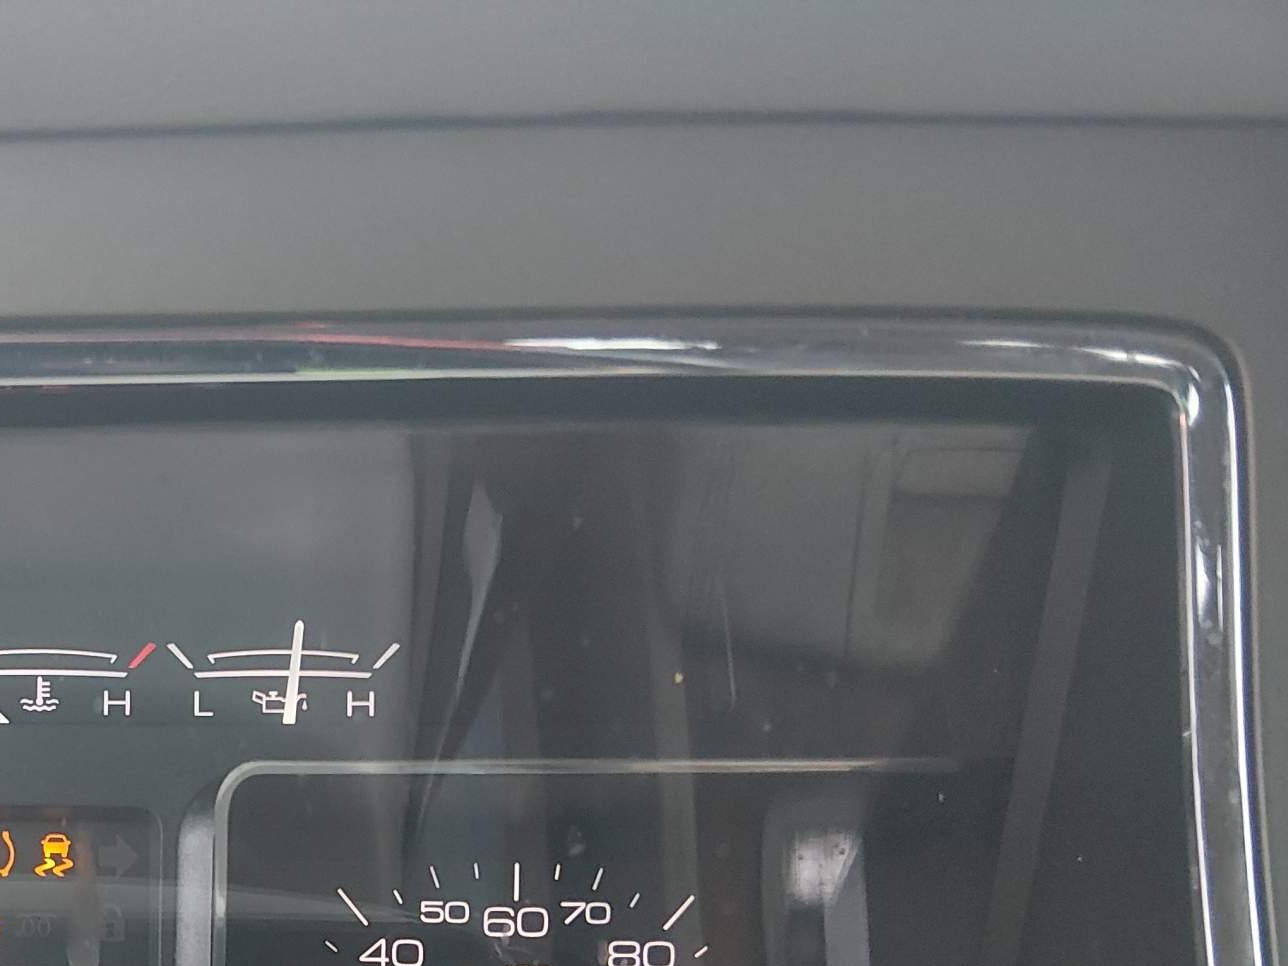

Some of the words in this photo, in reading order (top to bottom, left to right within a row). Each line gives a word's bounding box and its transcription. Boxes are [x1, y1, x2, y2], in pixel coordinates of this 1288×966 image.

[104, 691, 130, 715] H
[194, 691, 213, 716] L
[347, 691, 374, 716] H
[421, 901, 469, 923] 50
[484, 907, 548, 937] 60
[561, 902, 610, 924] 70
